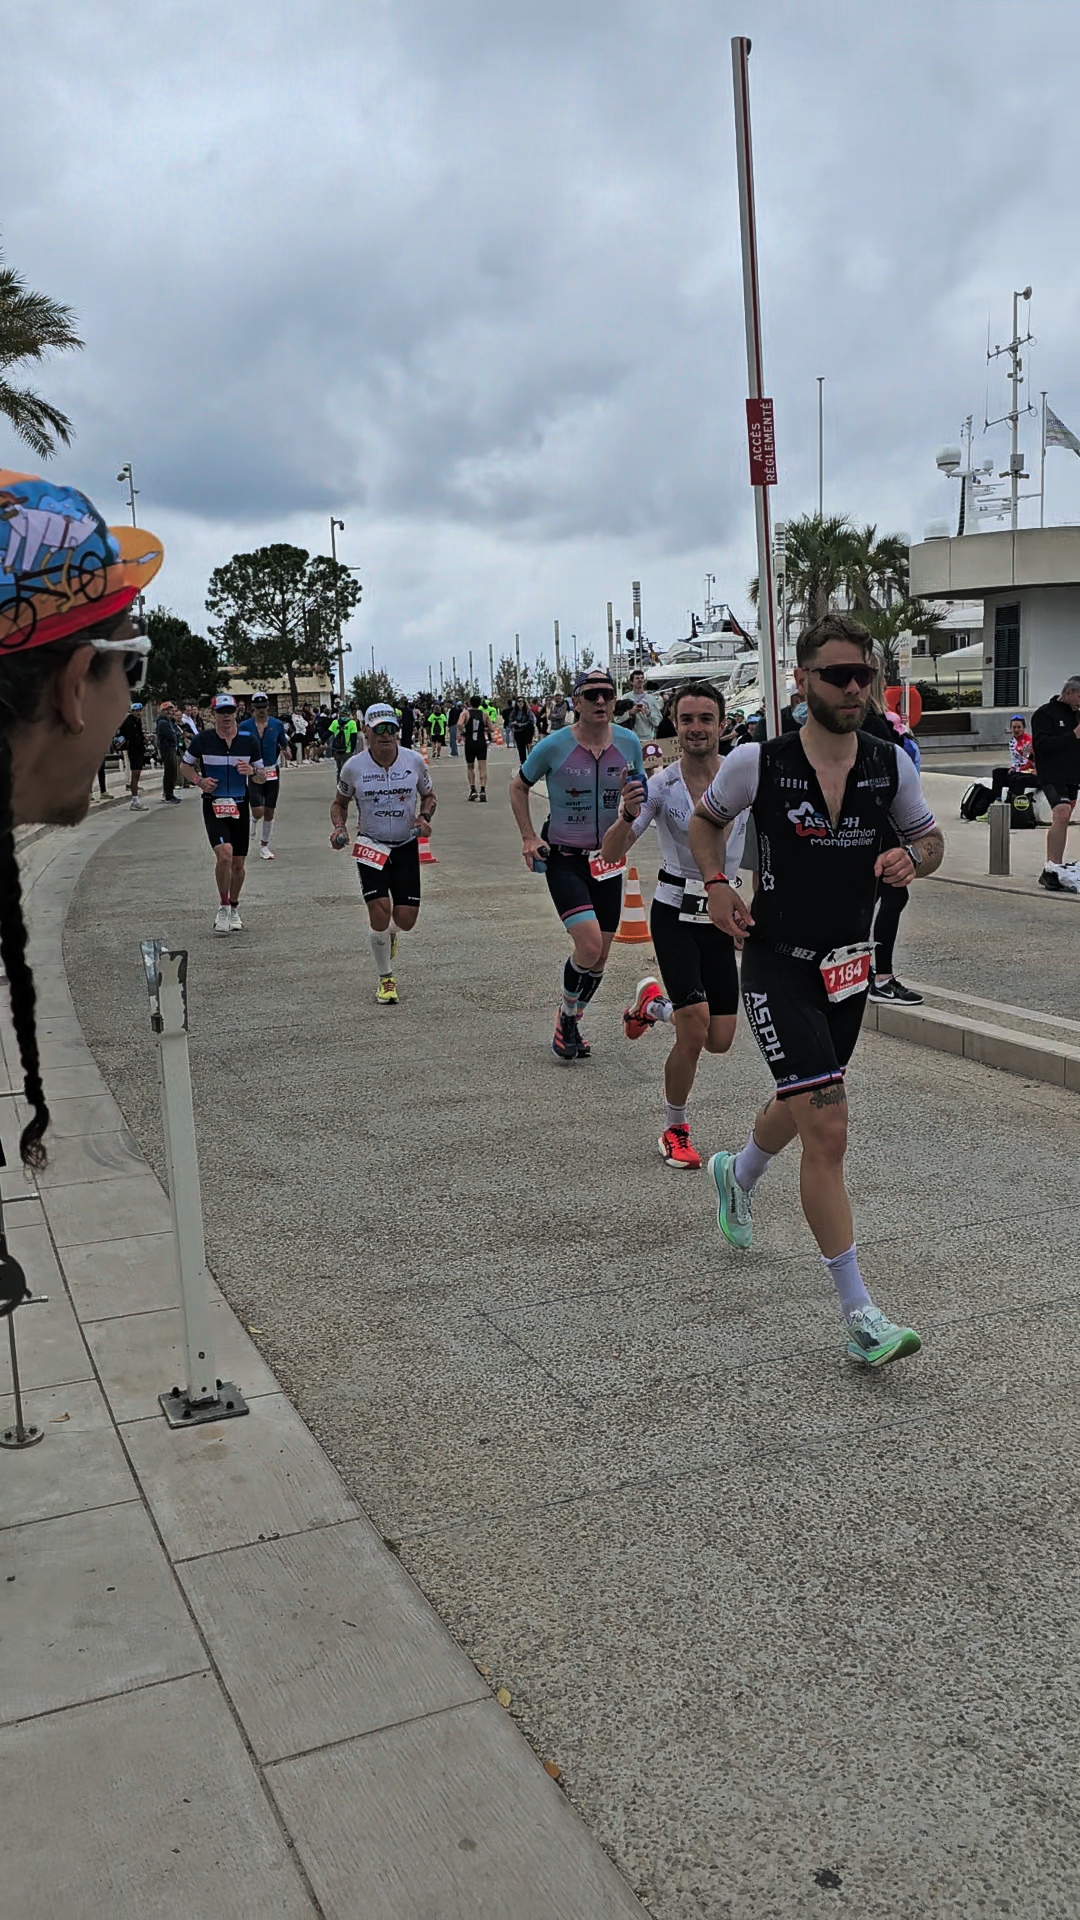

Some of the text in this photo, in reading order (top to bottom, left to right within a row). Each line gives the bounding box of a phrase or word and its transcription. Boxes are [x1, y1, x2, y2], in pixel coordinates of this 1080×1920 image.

[760, 402, 776, 482] RÉGLEMENTÉ
[363, 788, 413, 797] TRI-ACADEMY
[357, 846, 382, 862] 1081
[828, 959, 863, 988] 1184
[750, 991, 786, 1063] ASPH
